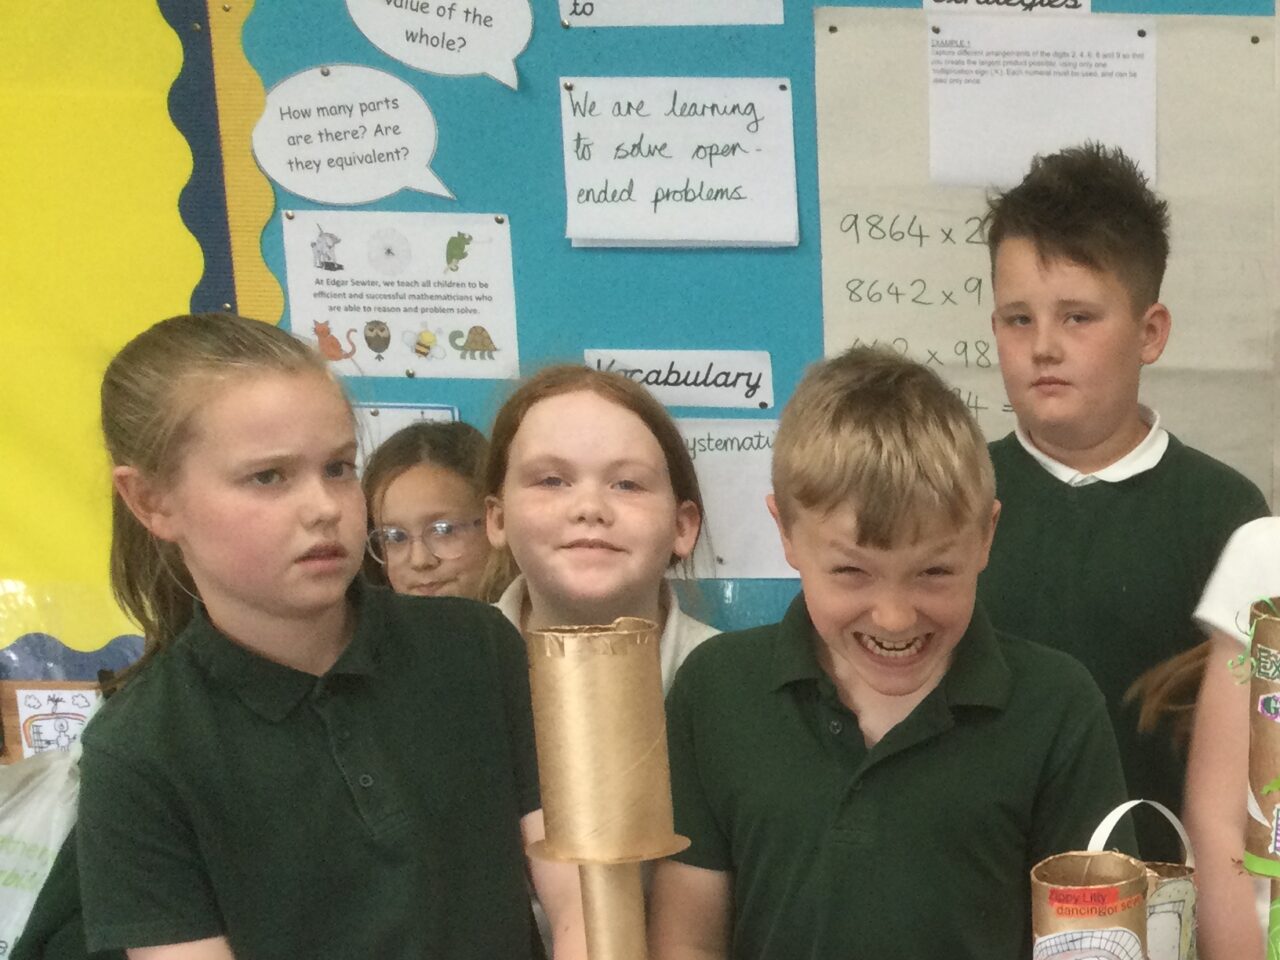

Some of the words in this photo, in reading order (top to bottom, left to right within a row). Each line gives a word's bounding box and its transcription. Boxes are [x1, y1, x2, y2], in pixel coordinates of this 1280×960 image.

[436, 2, 456, 20] of
[464, 8, 493, 28] the
[569, 0, 594, 16] to
[405, 27, 467, 53] whole?
[279, 106, 312, 121] How
[316, 104, 354, 118] many
[359, 97, 400, 117] parts
[569, 90, 601, 118] We
[612, 100, 651, 118] are
[664, 90, 765, 133] learning
[287, 134, 313, 146] are
[318, 125, 367, 143] there?
[374, 123, 401, 138] Are
[572, 132, 595, 161] to
[614, 133, 673, 160] solve
[287, 157, 322, 174] they
[327, 147, 410, 171] equivalent?
[577, 178, 637, 204] ended
[840, 212, 930, 248] 9864
[313, 291, 346, 300] efficient
[349, 292, 363, 300] and
[365, 292, 407, 301] successful
[408, 293, 473, 302] mathematicians
[475, 294, 493, 302] who
[314, 278, 324, 286] At
[326, 278, 348, 288] Edgar
[397, 280, 418, 288] teach
[422, 280, 431, 288] all
[433, 280, 466, 289] children
[479, 281, 489, 289] be
[846, 278, 934, 305] 8642
[343, 304, 361, 313] able
[363, 305, 372, 313] to
[421, 306, 455, 315] problem
